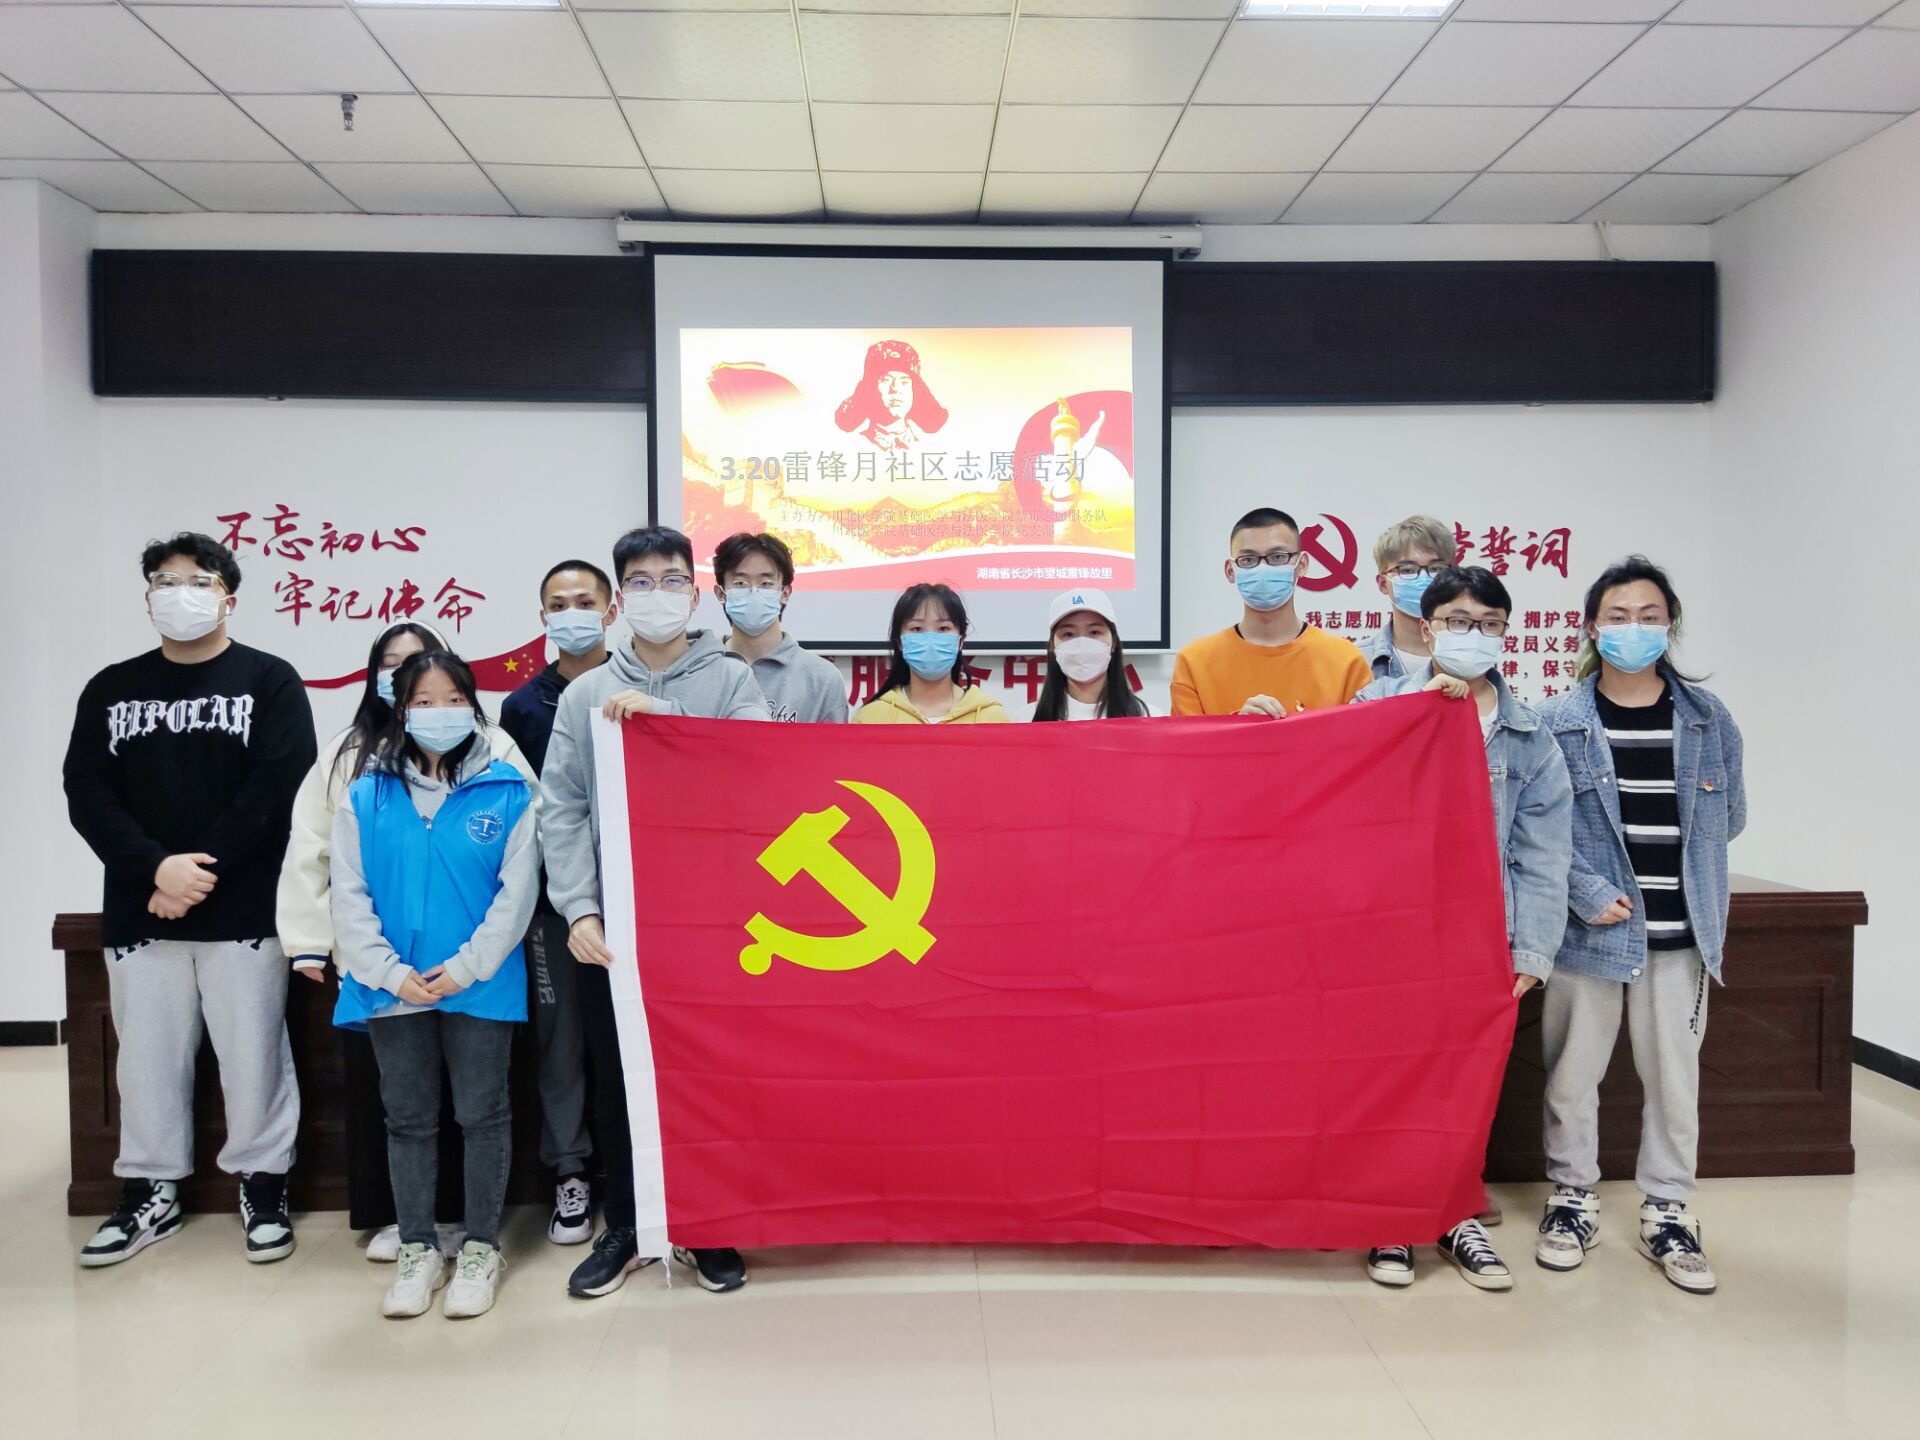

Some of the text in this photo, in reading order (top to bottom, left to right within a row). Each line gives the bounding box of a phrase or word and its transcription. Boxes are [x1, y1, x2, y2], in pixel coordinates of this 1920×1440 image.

[720, 450, 1086, 482] 3.20雷锋月社区志愿活动
[216, 503, 427, 562] 不忘初心
[976, 567, 1113, 579] 湖南省长沙市望城雷锋故里
[273, 571, 487, 634] 牢记使命
[1072, 595, 1085, 605] LA
[1523, 610, 1580, 629] 拥护党
[1503, 635, 1580, 653] 党员义务
[107, 693, 255, 757] BIPOLAR
